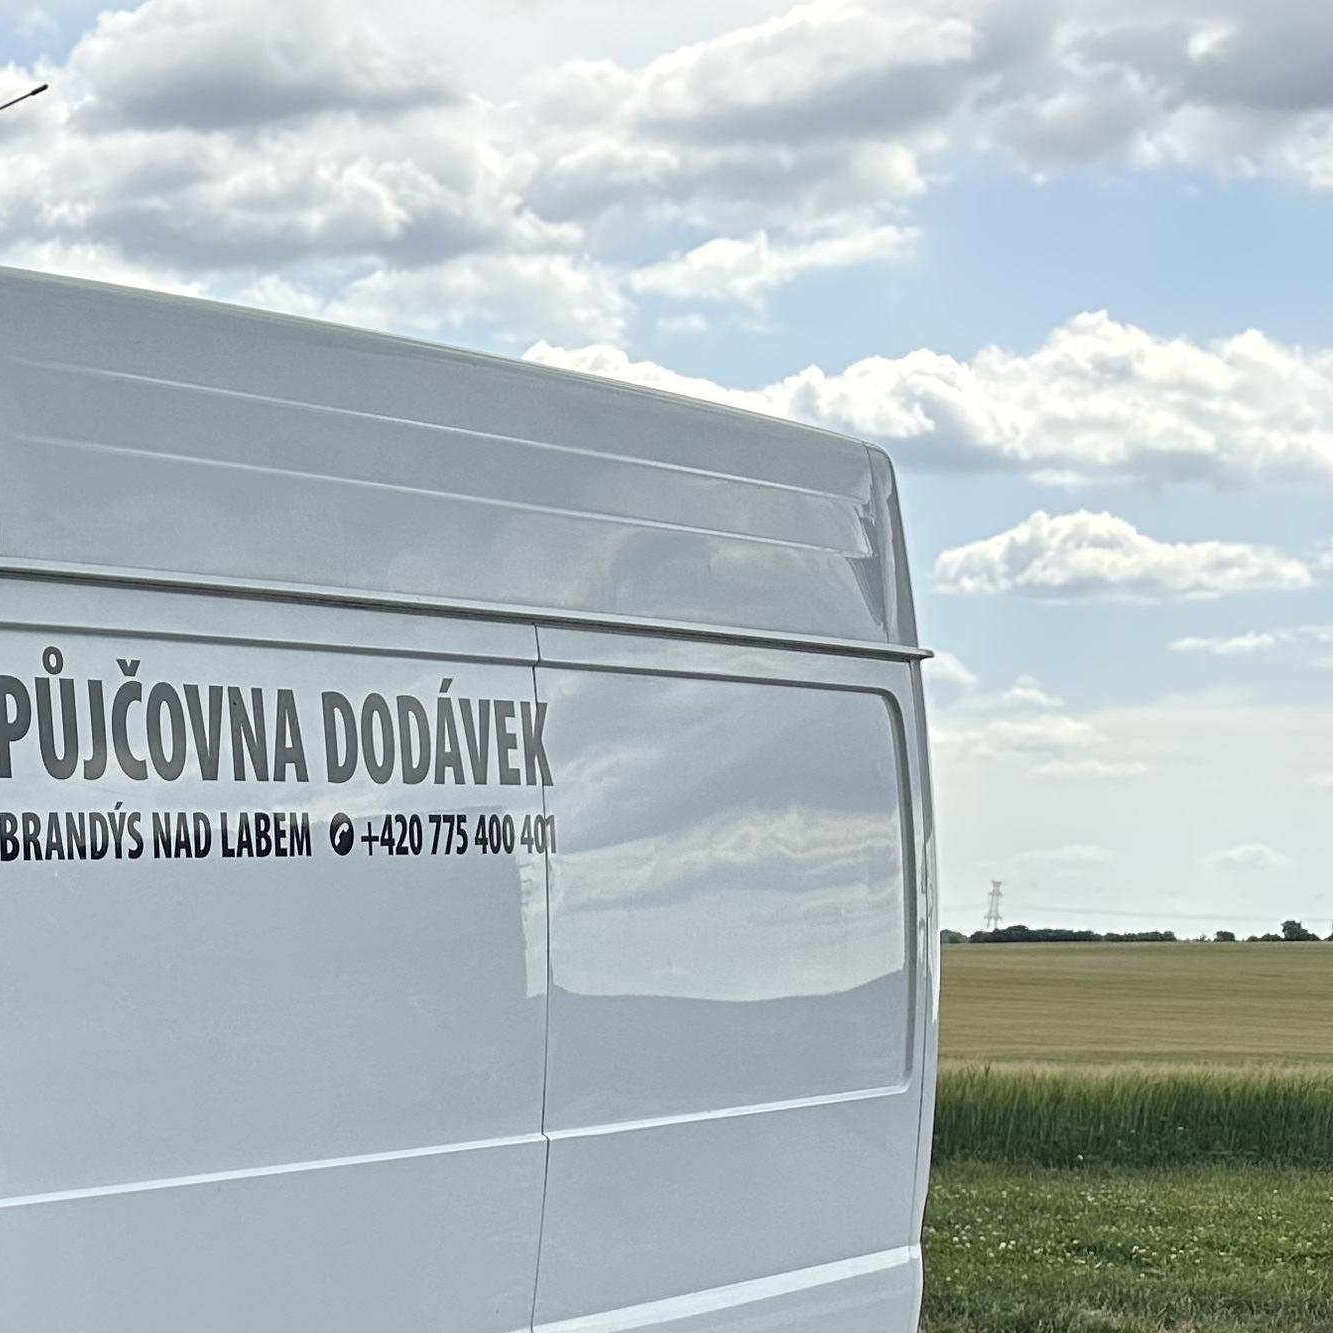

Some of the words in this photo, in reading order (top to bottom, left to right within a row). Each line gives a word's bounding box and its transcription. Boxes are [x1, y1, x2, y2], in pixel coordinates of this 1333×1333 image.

[322, 678, 554, 787] DODÁVEK
[152, 811, 211, 860] NAD
[220, 812, 312, 859] LABEM
[360, 813, 423, 857] +420
[429, 814, 469, 856] 775
[474, 814, 515, 856] 400
[519, 814, 557, 855] 401
